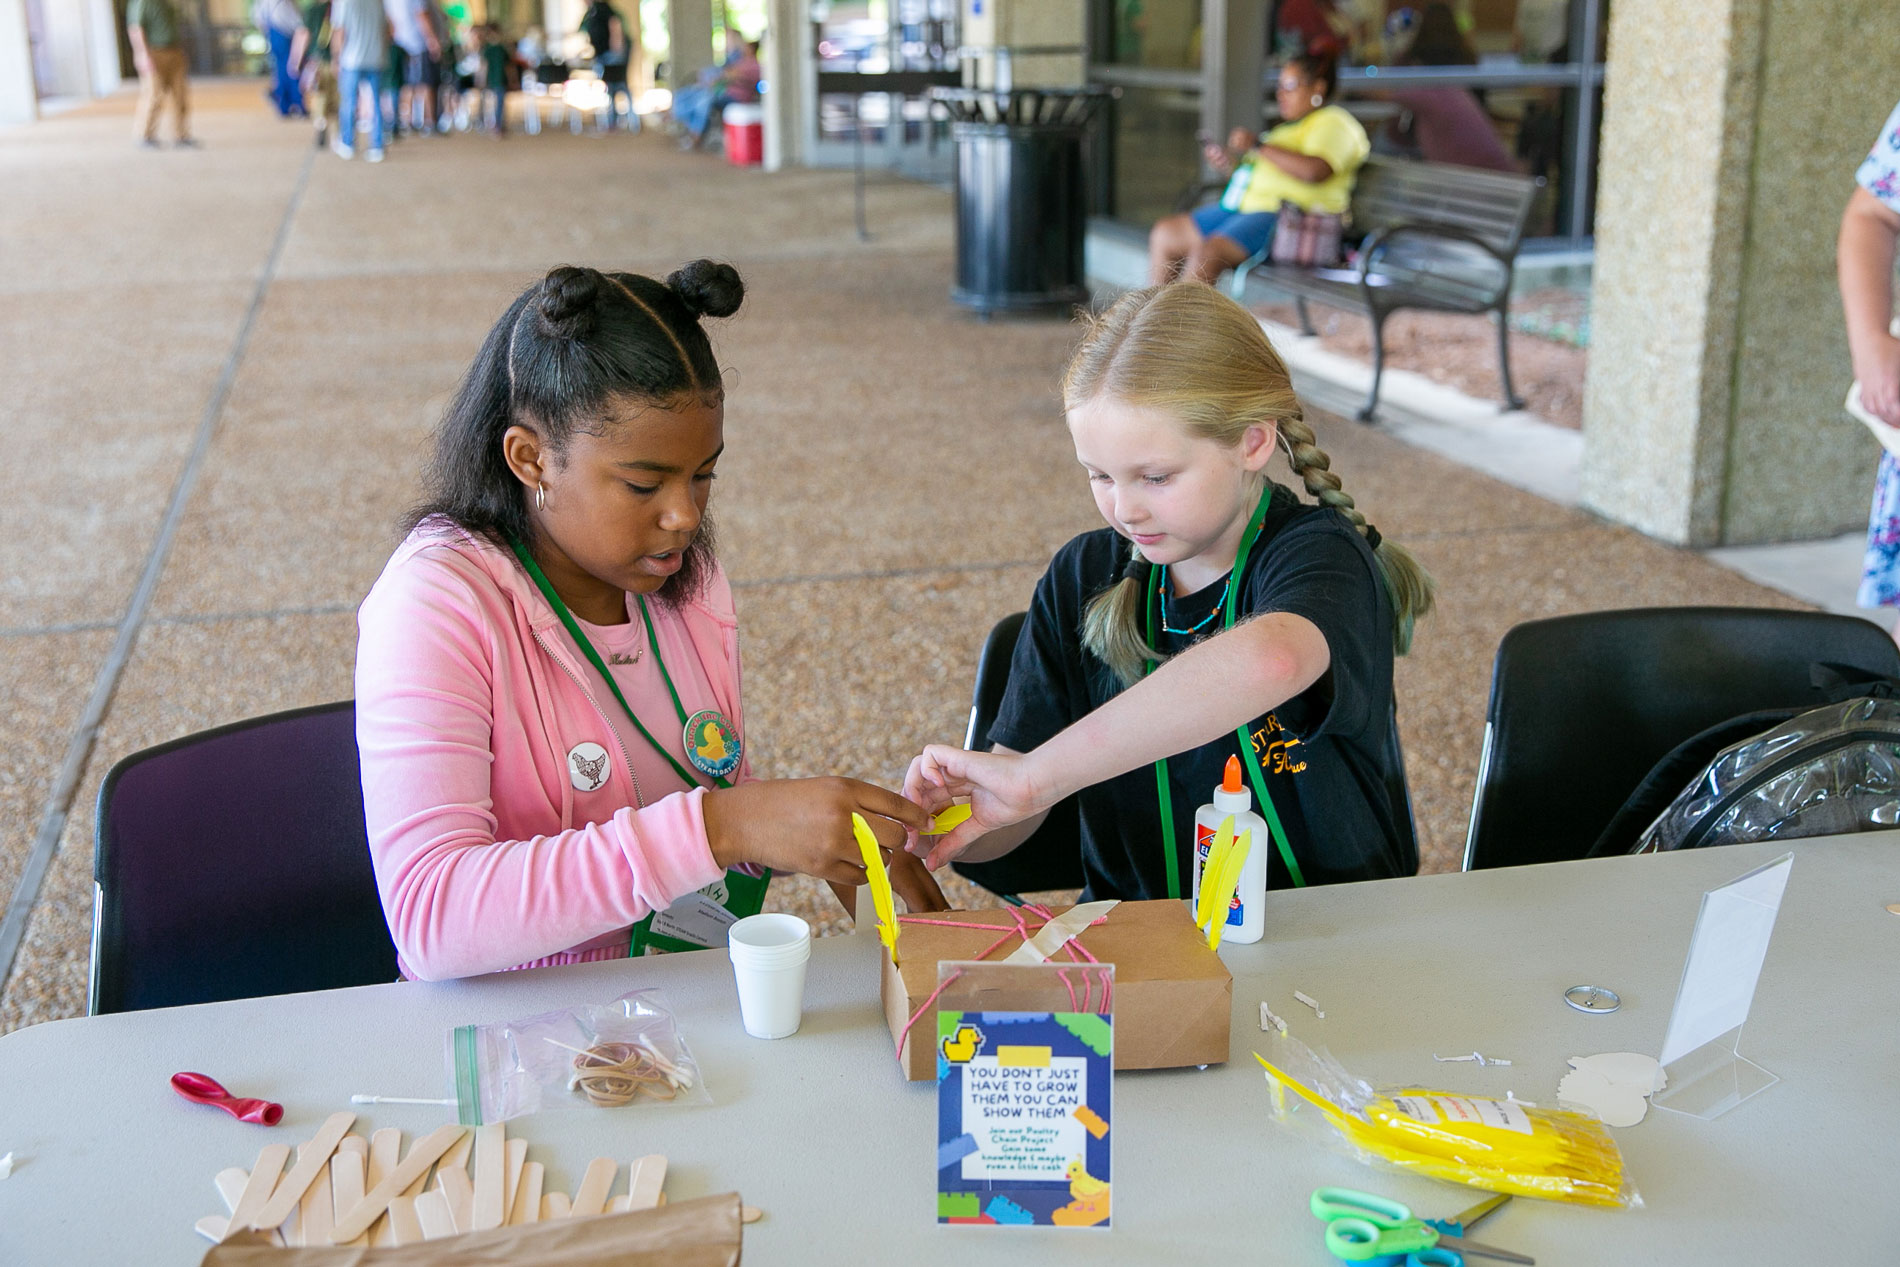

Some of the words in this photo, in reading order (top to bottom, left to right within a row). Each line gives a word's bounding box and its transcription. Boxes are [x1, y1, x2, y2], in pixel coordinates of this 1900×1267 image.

[687, 717, 702, 749] Quack
[719, 716, 737, 740] Code
[697, 760, 718, 775] STEAM
[719, 767, 732, 776] DAY
[969, 1068, 998, 1079] YOU
[1002, 1068, 1043, 1079] DON'T
[1048, 1068, 1080, 1079] JUST
[971, 1081, 1009, 1091] HAVE
[1014, 1081, 1032, 1091] TO
[1037, 1081, 1077, 1092] GROW
[972, 1094, 1009, 1104] THEM
[1014, 1094, 1042, 1104] YOU
[1046, 1094, 1078, 1105] CAN
[983, 1107, 1022, 1117] SHOW
[1028, 1107, 1066, 1118] THEM
[1026, 1126, 1059, 1136] Poultry
[1020, 1135, 1054, 1145] Project
[982, 1153, 1027, 1163] knowledge
[1038, 1154, 1066, 1163] maybe
[1018, 1162, 1038, 1170] little
